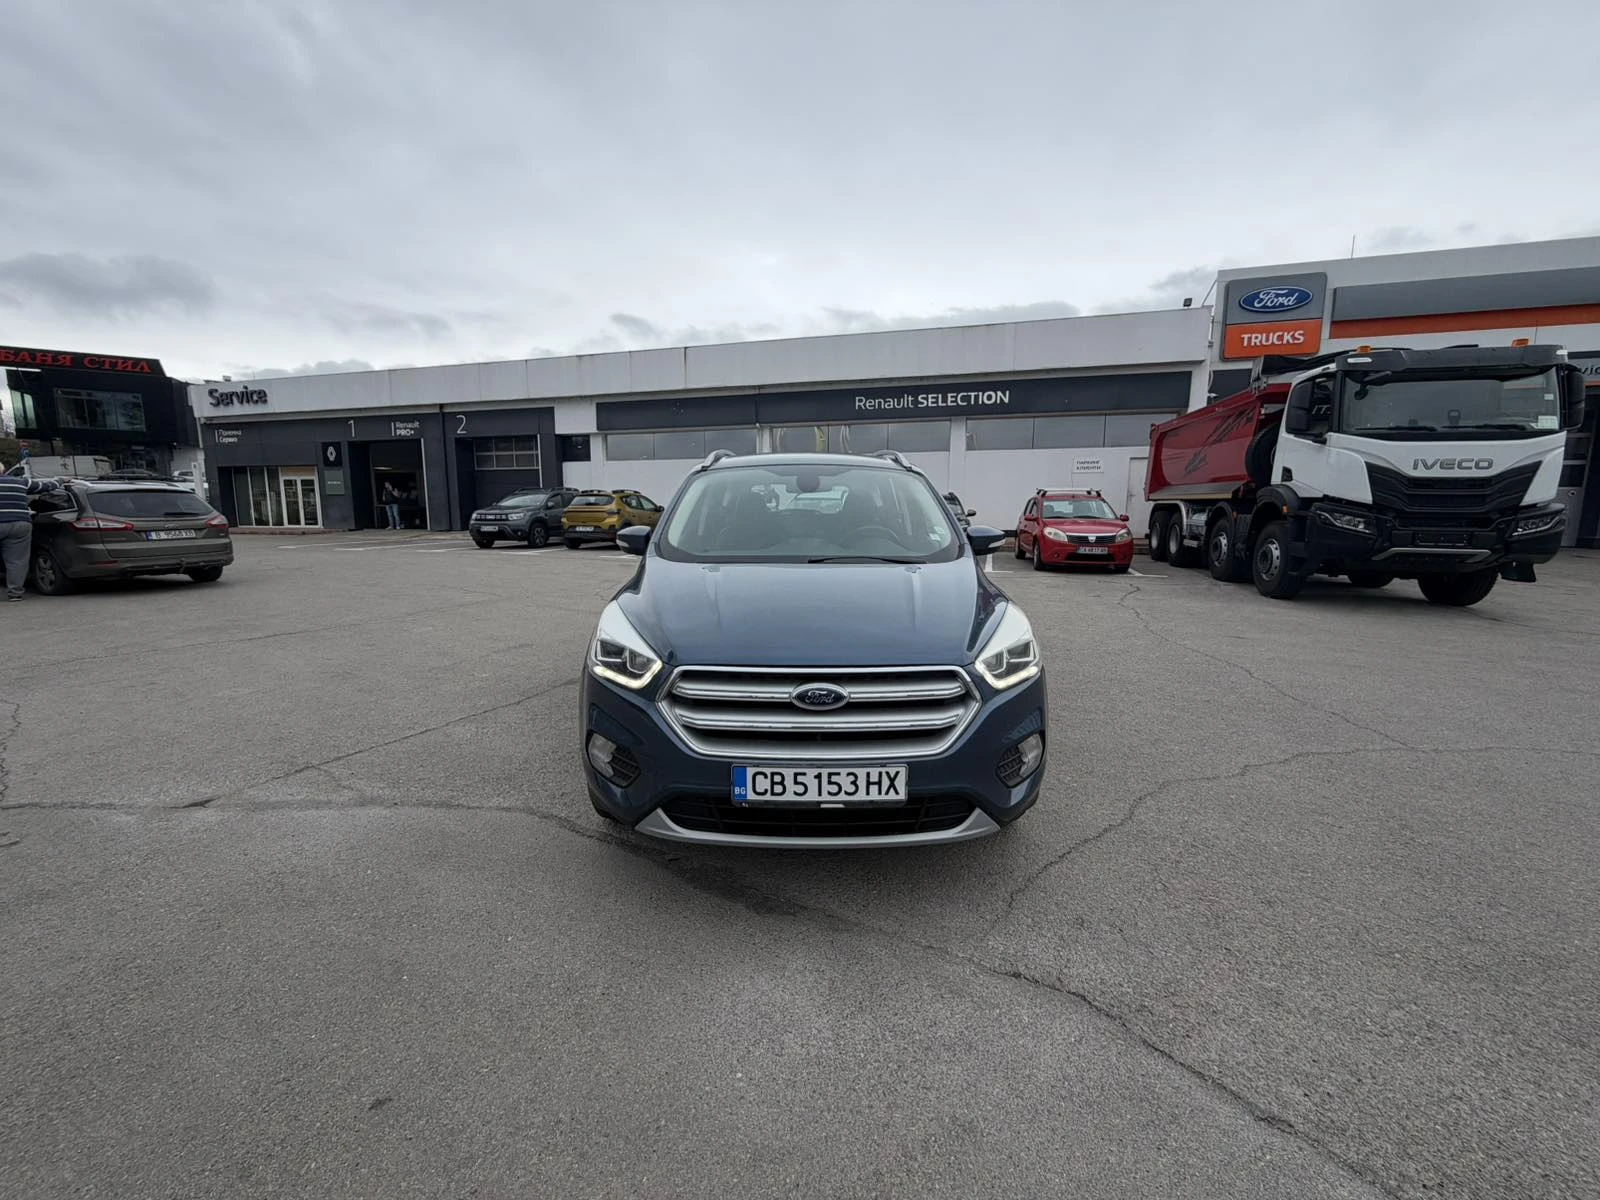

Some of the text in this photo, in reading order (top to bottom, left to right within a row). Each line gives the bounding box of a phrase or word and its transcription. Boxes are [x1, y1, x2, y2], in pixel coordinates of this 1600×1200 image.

[1253, 289, 1299, 308] Ford
[1241, 330, 1304, 347] TRUCKS
[83, 356, 151, 373] СТИЛ
[208, 385, 268, 408] Service
[855, 390, 1010, 410] Renault SELECTION
[348, 419, 355, 437] 1
[395, 421, 420, 429] Renault
[456, 415, 467, 434] 2
[1412, 458, 1494, 470] IVECO
[805, 690, 835, 703] Ford
[734, 771, 901, 797] BG CB 5153 HX
